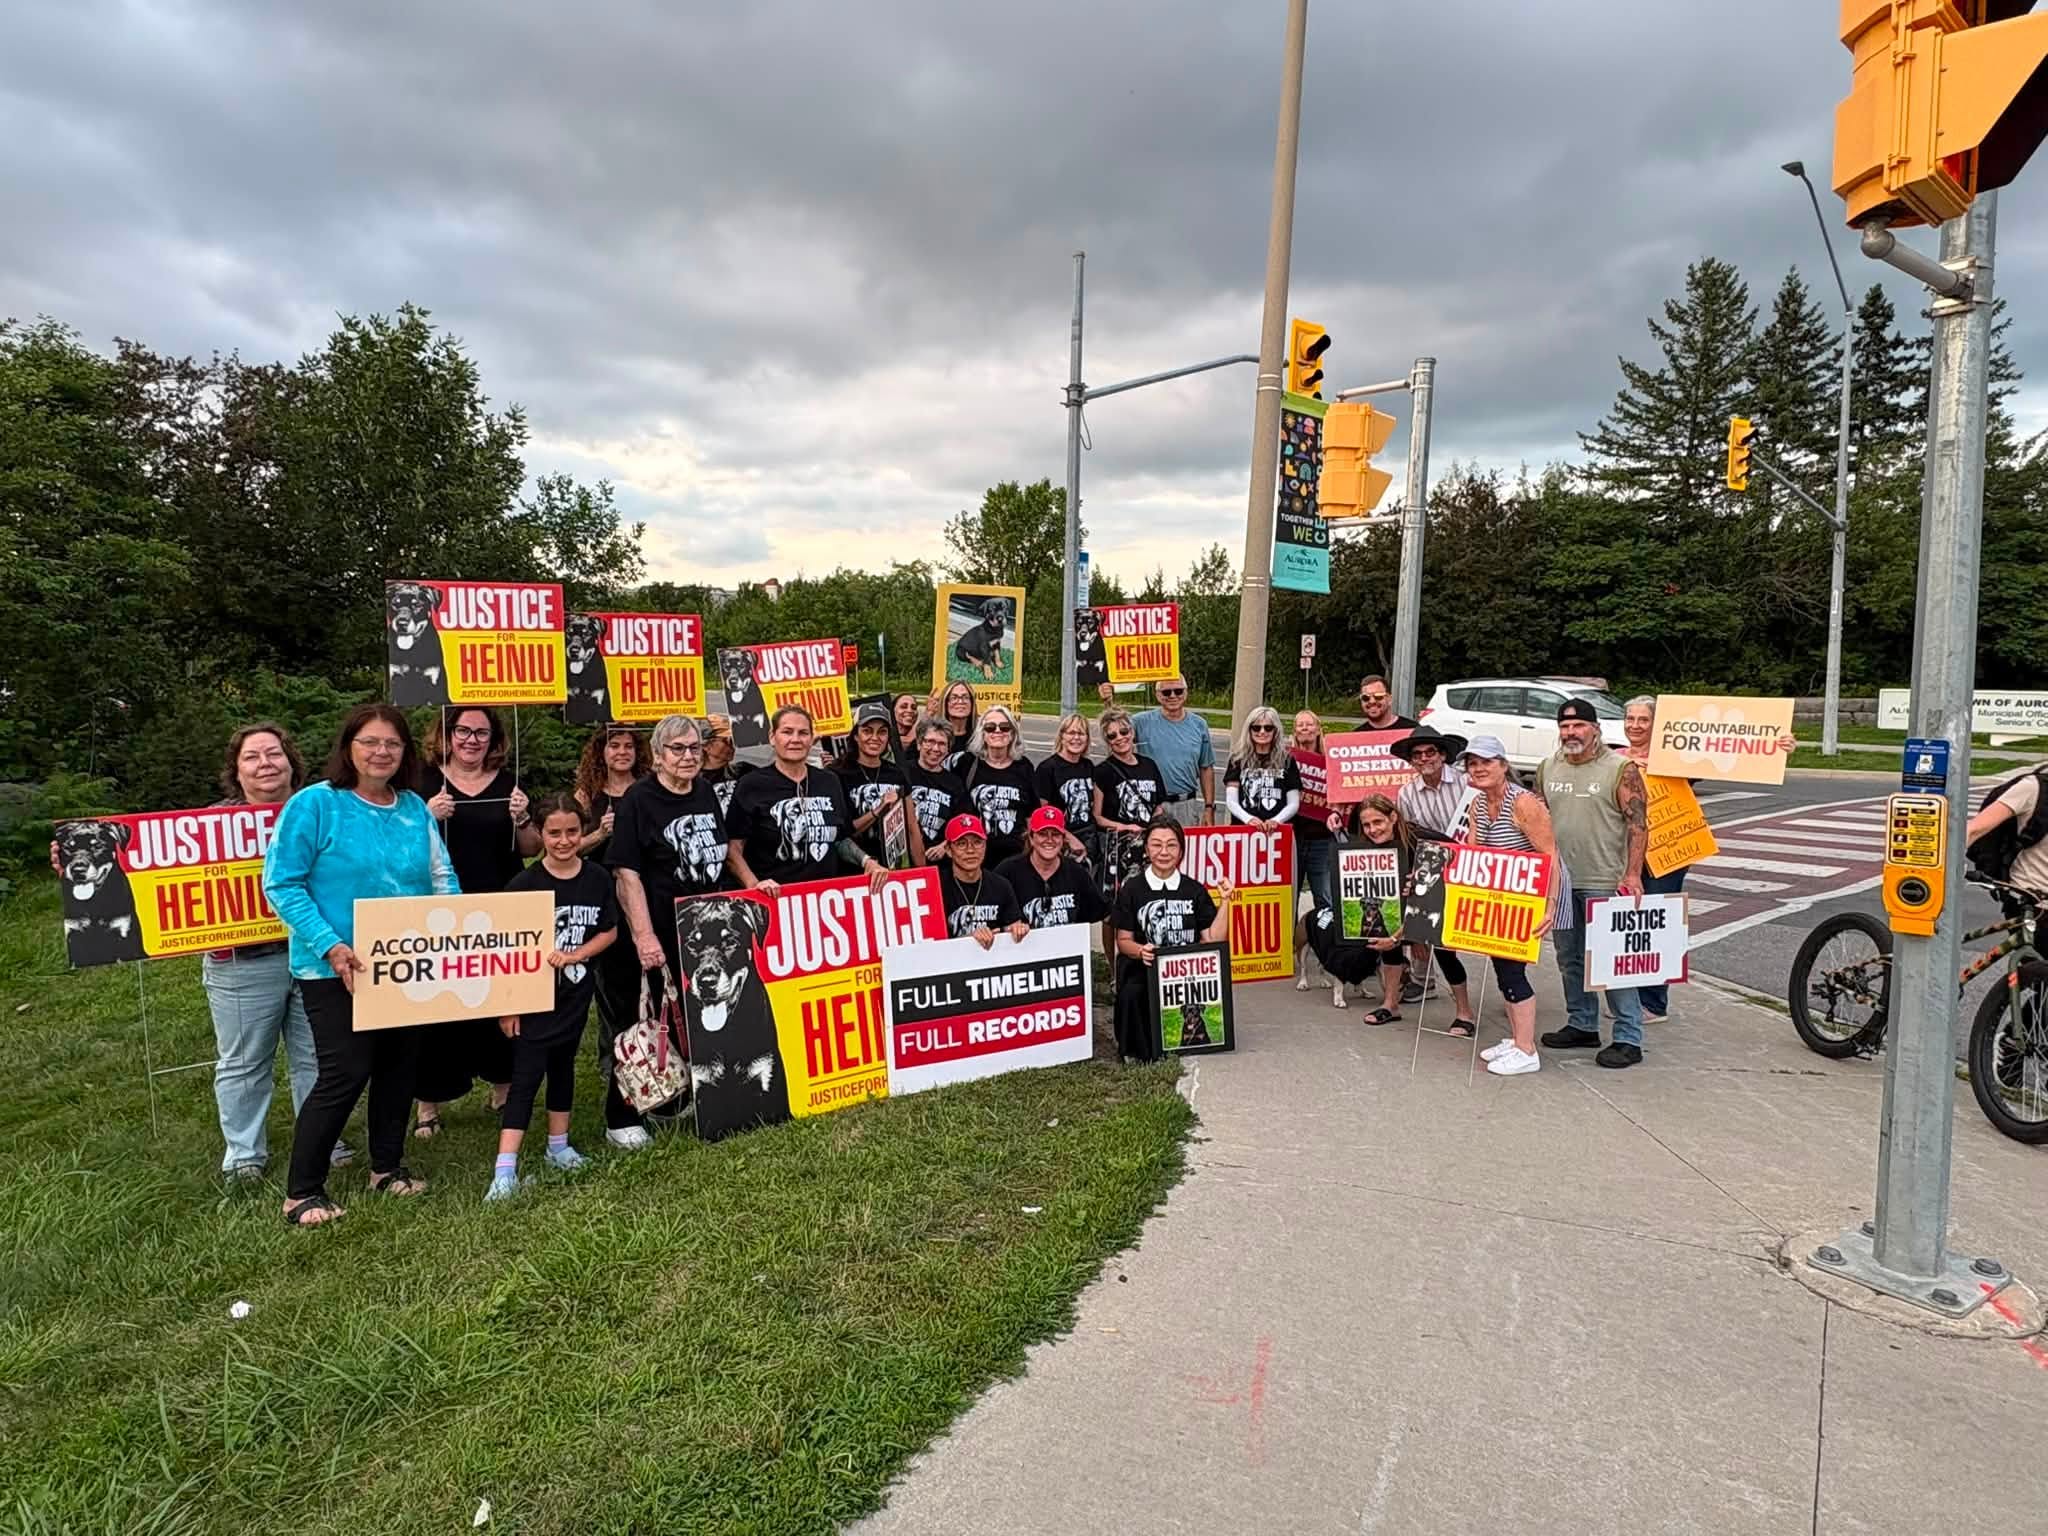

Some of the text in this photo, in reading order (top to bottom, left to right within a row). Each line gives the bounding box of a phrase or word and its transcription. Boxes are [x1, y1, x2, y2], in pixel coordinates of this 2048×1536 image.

[1281, 512, 1314, 526] TOGETHER
[1292, 525, 1314, 543] WE
[440, 586, 555, 630] JUSTICE
[1104, 606, 1173, 637] JUSTICE
[496, 632, 516, 642] FOR
[605, 617, 696, 656] JUSTICE
[459, 643, 555, 684] HEINIU
[650, 658, 666, 667] FOR
[758, 643, 839, 683] JUSTICE
[1115, 642, 1172, 670] HEINIU
[620, 667, 697, 704] HEINIU
[1971, 698, 1991, 706] WN
[1994, 698, 2012, 707] OF
[1977, 709, 2024, 718] Municipal
[1663, 720, 1782, 738] ACCOUNTABILITY
[1328, 743, 1392, 759] COMMU
[1661, 734, 1778, 756] FOR HEINIU
[805, 810, 825, 826] FOR
[127, 809, 274, 870] JUSTICE
[204, 865, 229, 877] FOR
[1182, 831, 1283, 887] USTICE
[1341, 852, 1395, 871] JUSTICE
[1448, 848, 1543, 895] JUSTICE
[1343, 876, 1397, 899] HEINIU
[1487, 891, 1505, 902] FOR
[1165, 899, 1195, 915] JUSTICE
[766, 878, 936, 977] JUSTICE
[1166, 914, 1184, 930] FOR
[1232, 902, 1281, 957] NIU
[1453, 896, 1535, 944] HEINIU
[1610, 908, 1667, 933] JUSTICE
[158, 924, 283, 950] JUSTICEFORHEINIU.COM
[370, 929, 543, 957] ACCOUNTABILITY
[1167, 928, 1196, 943] HEINIU
[1624, 931, 1652, 954] FOR
[373, 950, 542, 986] FOR HEINIU
[1161, 955, 1217, 979] JUSTICE
[1613, 952, 1661, 977] HEINIU
[855, 967, 883, 988] FOR
[897, 963, 1080, 1012] FULL TIMELINE
[1162, 979, 1219, 1007] HEINIU
[900, 1004, 1081, 1056] FULL RECORDS
